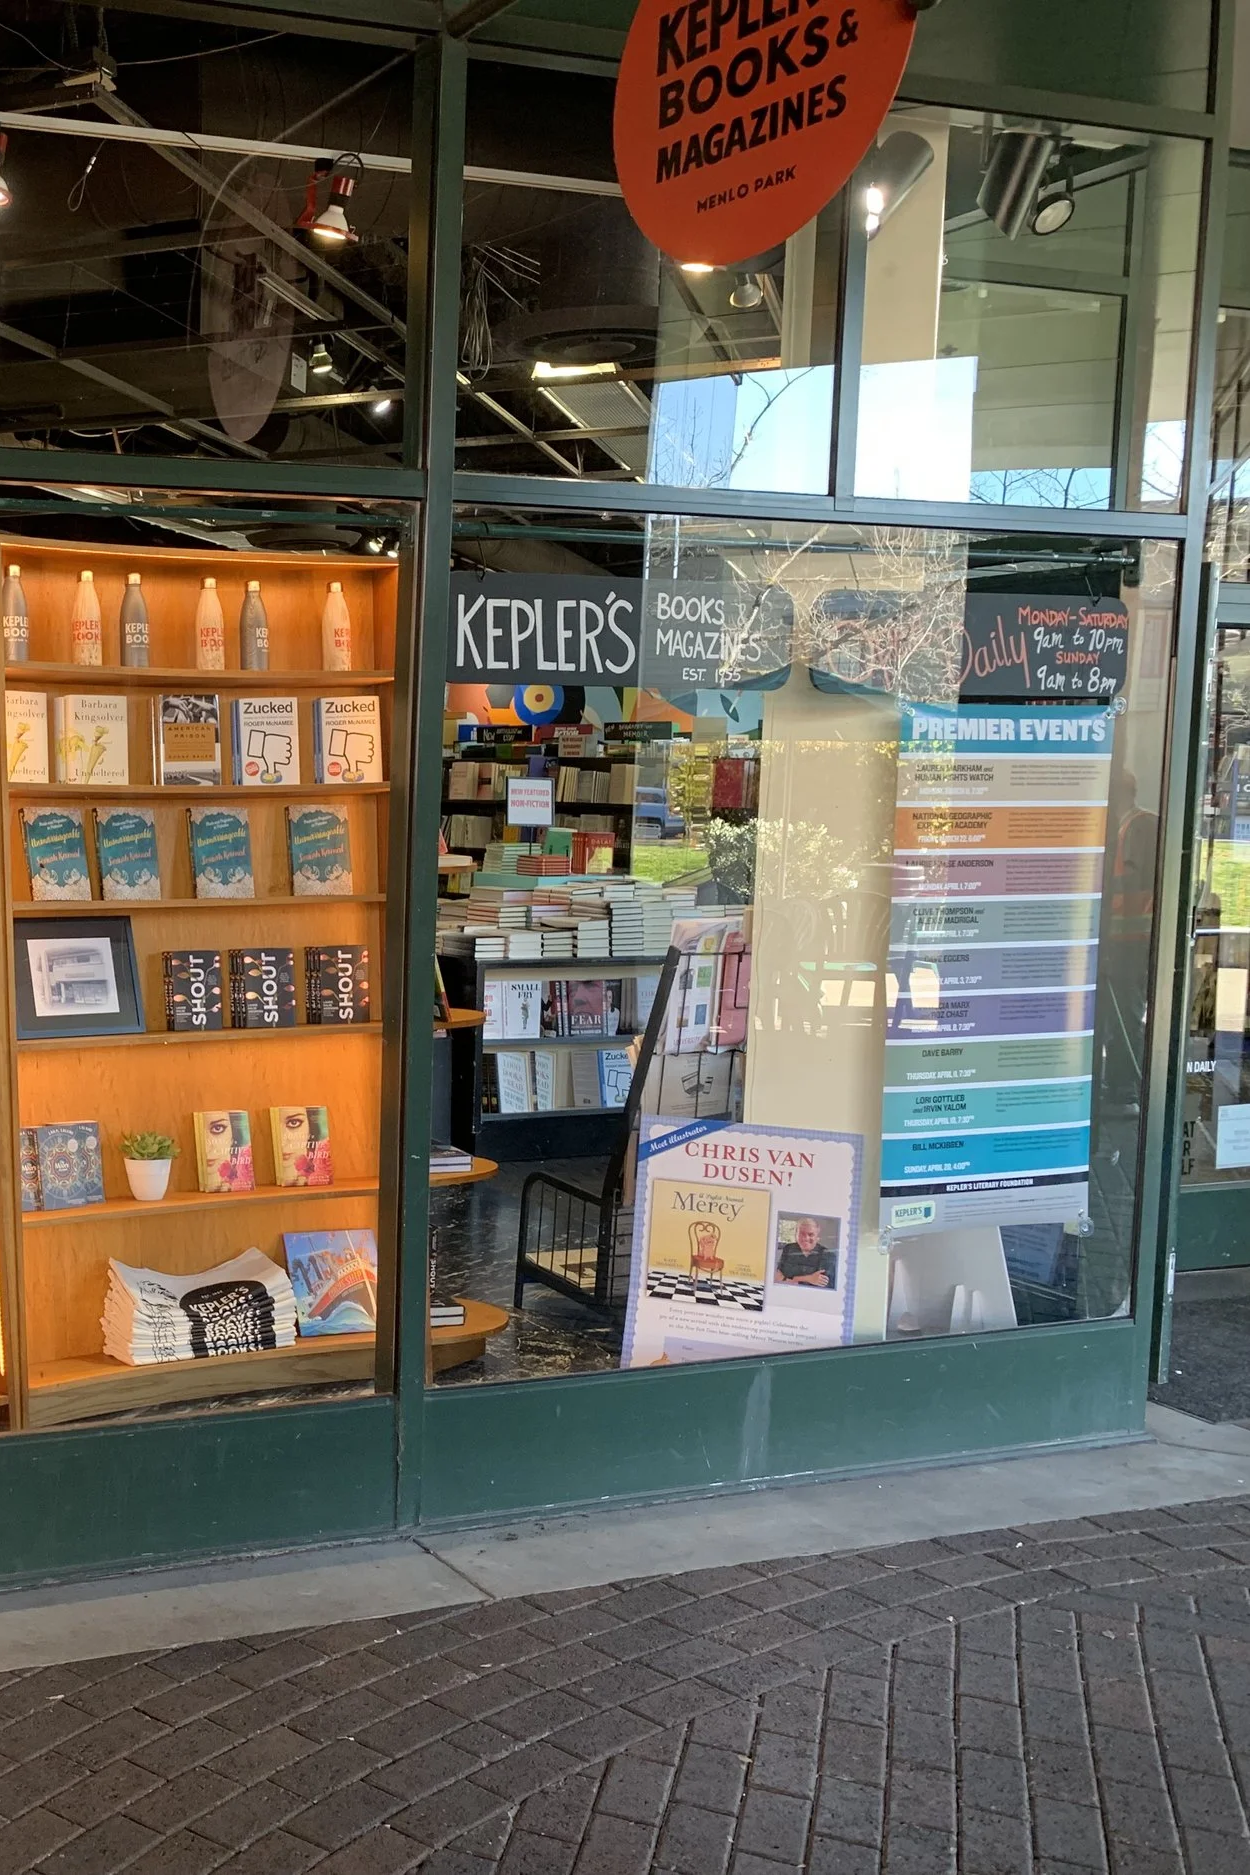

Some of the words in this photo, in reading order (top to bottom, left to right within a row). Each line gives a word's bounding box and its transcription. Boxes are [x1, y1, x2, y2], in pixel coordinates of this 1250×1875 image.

[659, 16, 829, 130] BOOKS
[836, 8, 859, 48] &
[655, 74, 847, 184] MAGAZINES
[697, 183, 749, 213] MENLO
[754, 165, 797, 193] PARK
[657, 592, 725, 625] BOOKS
[455, 591, 636, 675] KEPLER'S
[656, 629, 762, 663] MAGAZINES
[1033, 627, 1064, 654] 9am
[1073, 628, 1084, 645] to
[1088, 628, 1124, 655] 10pm
[1055, 651, 1100, 665] SUNDAY
[682, 667, 706, 682] EST.
[1036, 665, 1066, 691] 9am
[1071, 672, 1083, 689] to
[1087, 666, 1117, 694] 8pm
[74, 712, 125, 723] Kingsolver
[81, 699, 118, 709] Barbara
[243, 701, 293, 714] Zucked
[325, 701, 375, 713] Zucked
[912, 718, 1015, 740] PREMIER
[1020, 718, 1106, 742] EVENTS
[189, 954, 206, 1026] SHOUT
[261, 952, 278, 1023] SHOUT
[338, 950, 353, 1020] SHOUT
[571, 1014, 601, 1025] FEAR
[1194, 1060, 1216, 1073] DAILY
[649, 1137, 669, 1153] Meet
[667, 1125, 708, 1147] illustrator
[685, 1141, 760, 1163] CHRIS
[766, 1149, 816, 1169] VAN
[703, 1163, 793, 1187] DUSEN!
[946, 1183, 973, 1192] KEPLER'S
[973, 1181, 1000, 1190] LITERARY
[1000, 1178, 1034, 1188] FOUNDATION
[671, 1191, 745, 1222] Mercy
[189, 1286, 249, 1314] KEPLER'S
